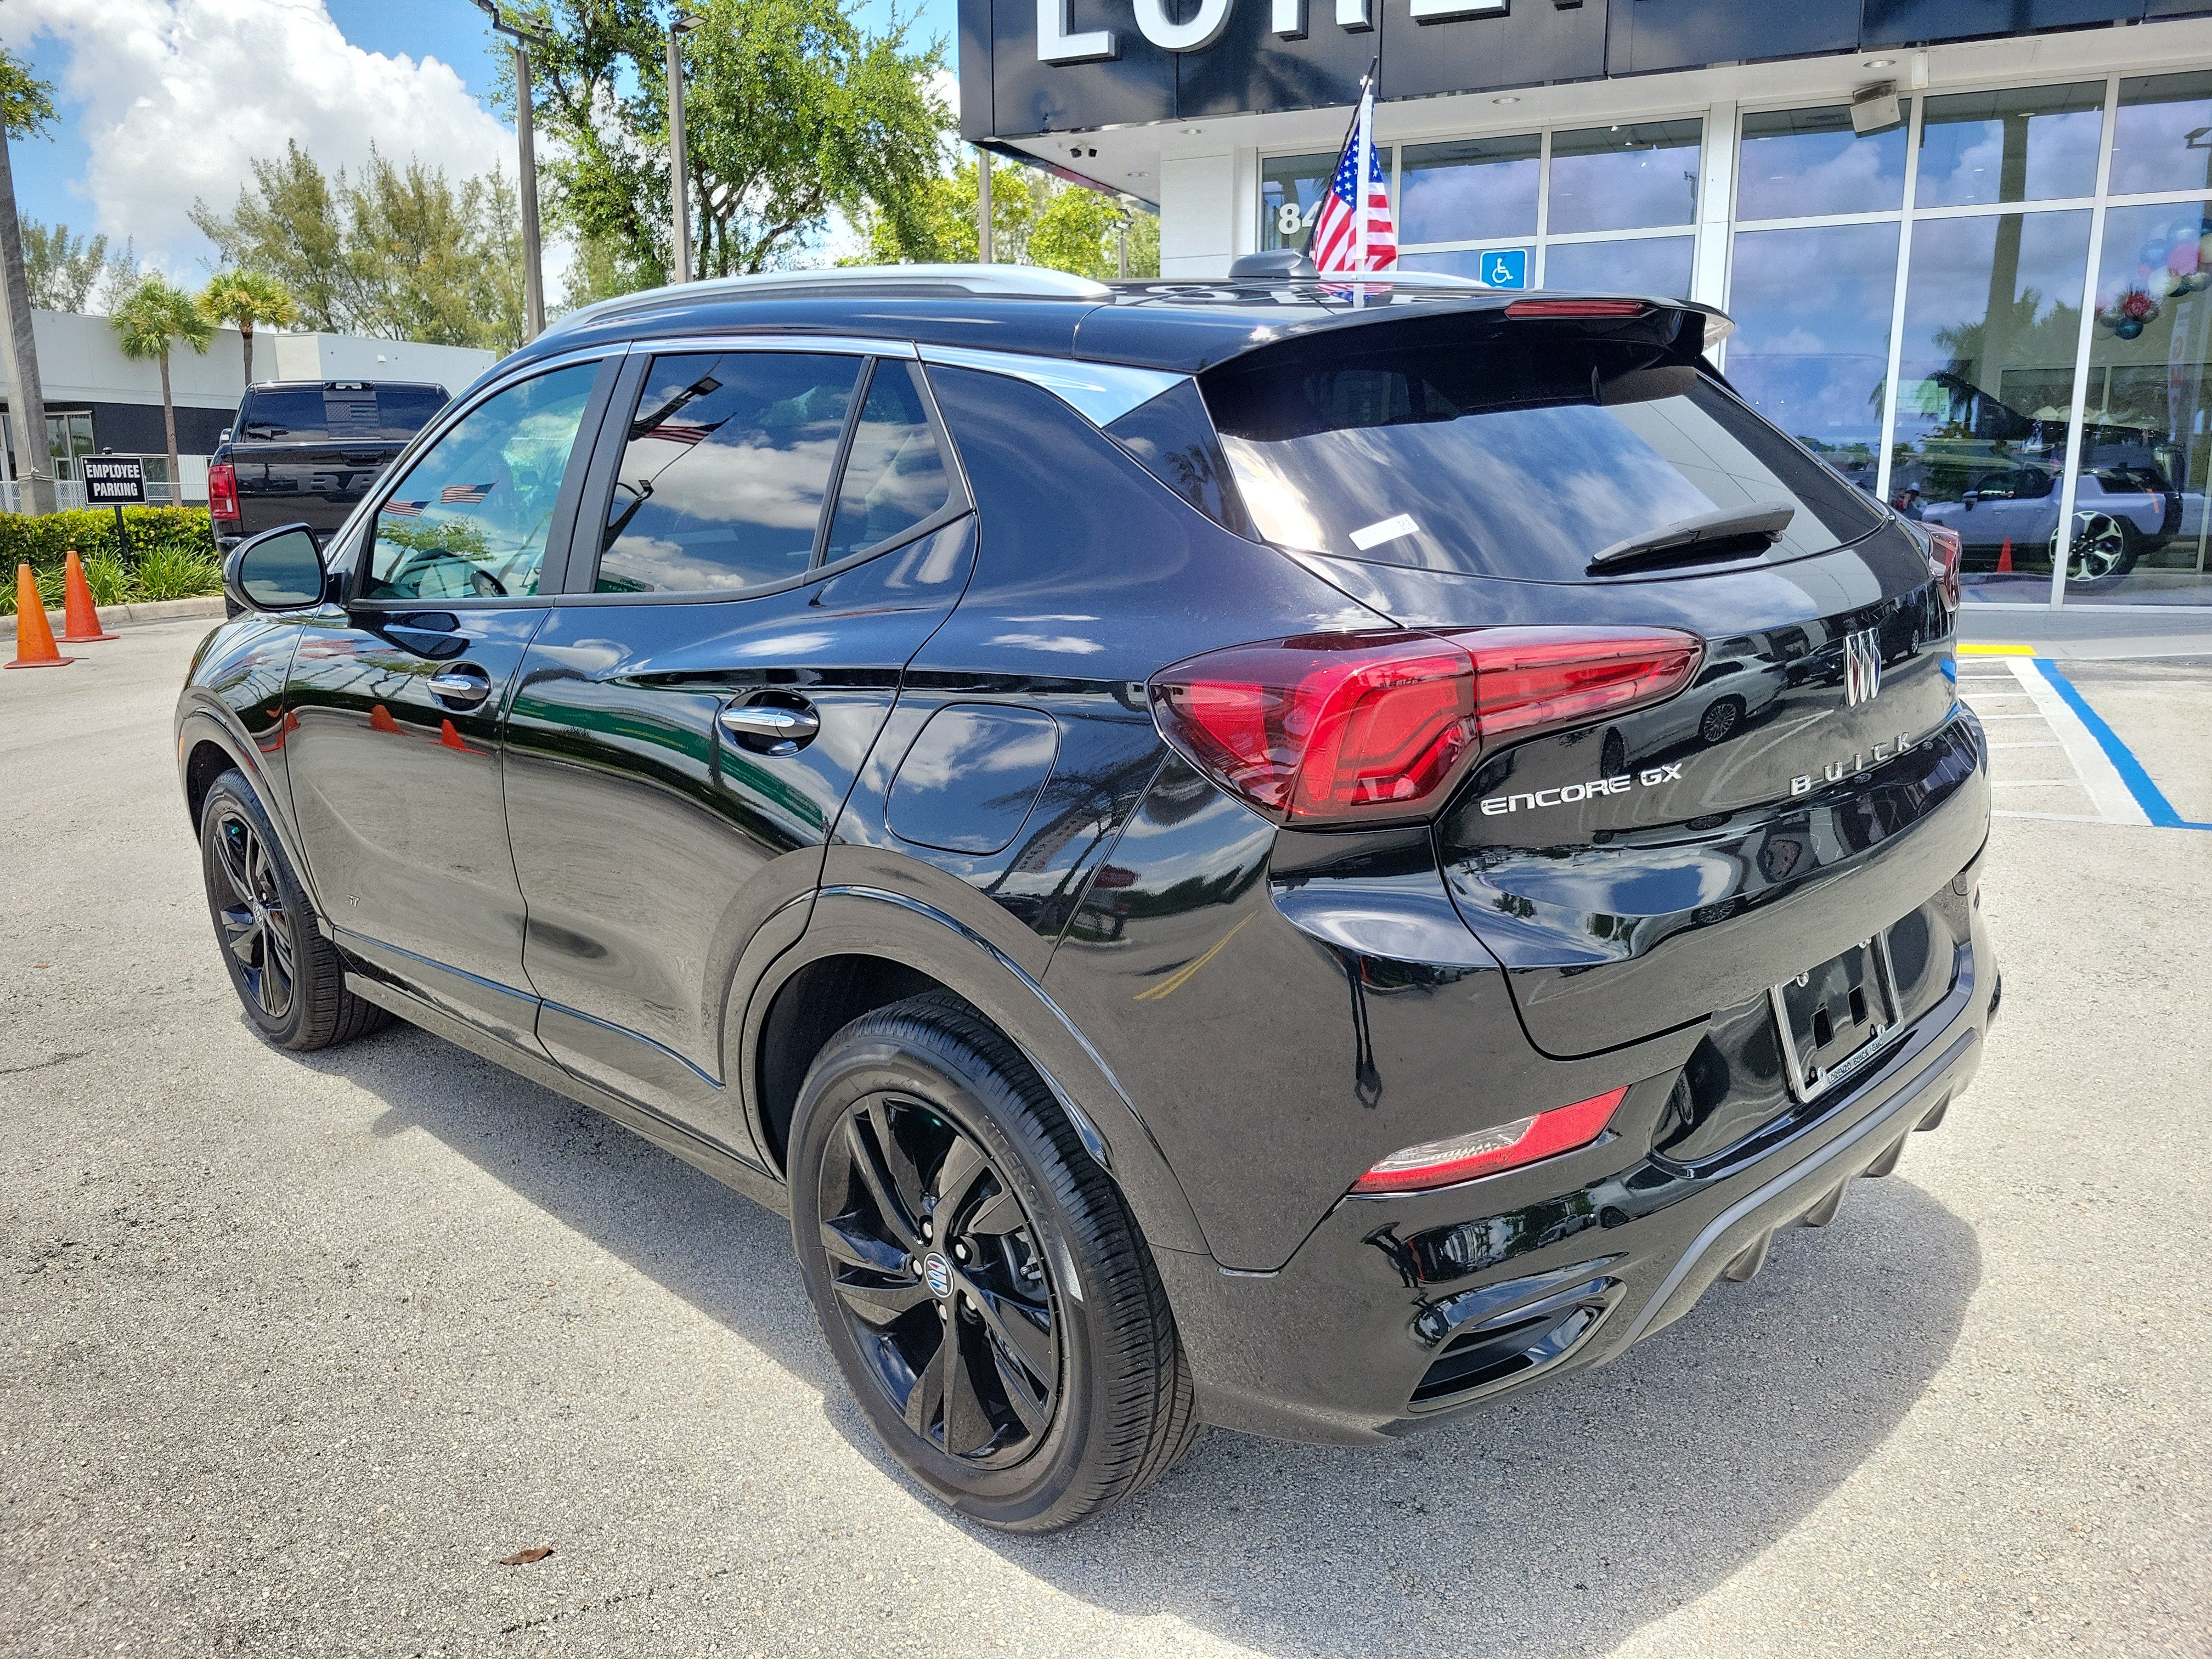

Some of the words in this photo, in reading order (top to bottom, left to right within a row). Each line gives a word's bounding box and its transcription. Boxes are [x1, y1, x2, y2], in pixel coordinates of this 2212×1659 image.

[86, 464, 140, 478] EMPLOYEE
[93, 482, 138, 496] PARKING
[297, 473, 377, 492] RA
[1790, 732, 1910, 795] BUICK
[1481, 775, 1631, 815] ENCORE
[1639, 763, 1682, 786] GX
[345, 894, 360, 906] ST
[1853, 1049, 1869, 1065] BUICK
